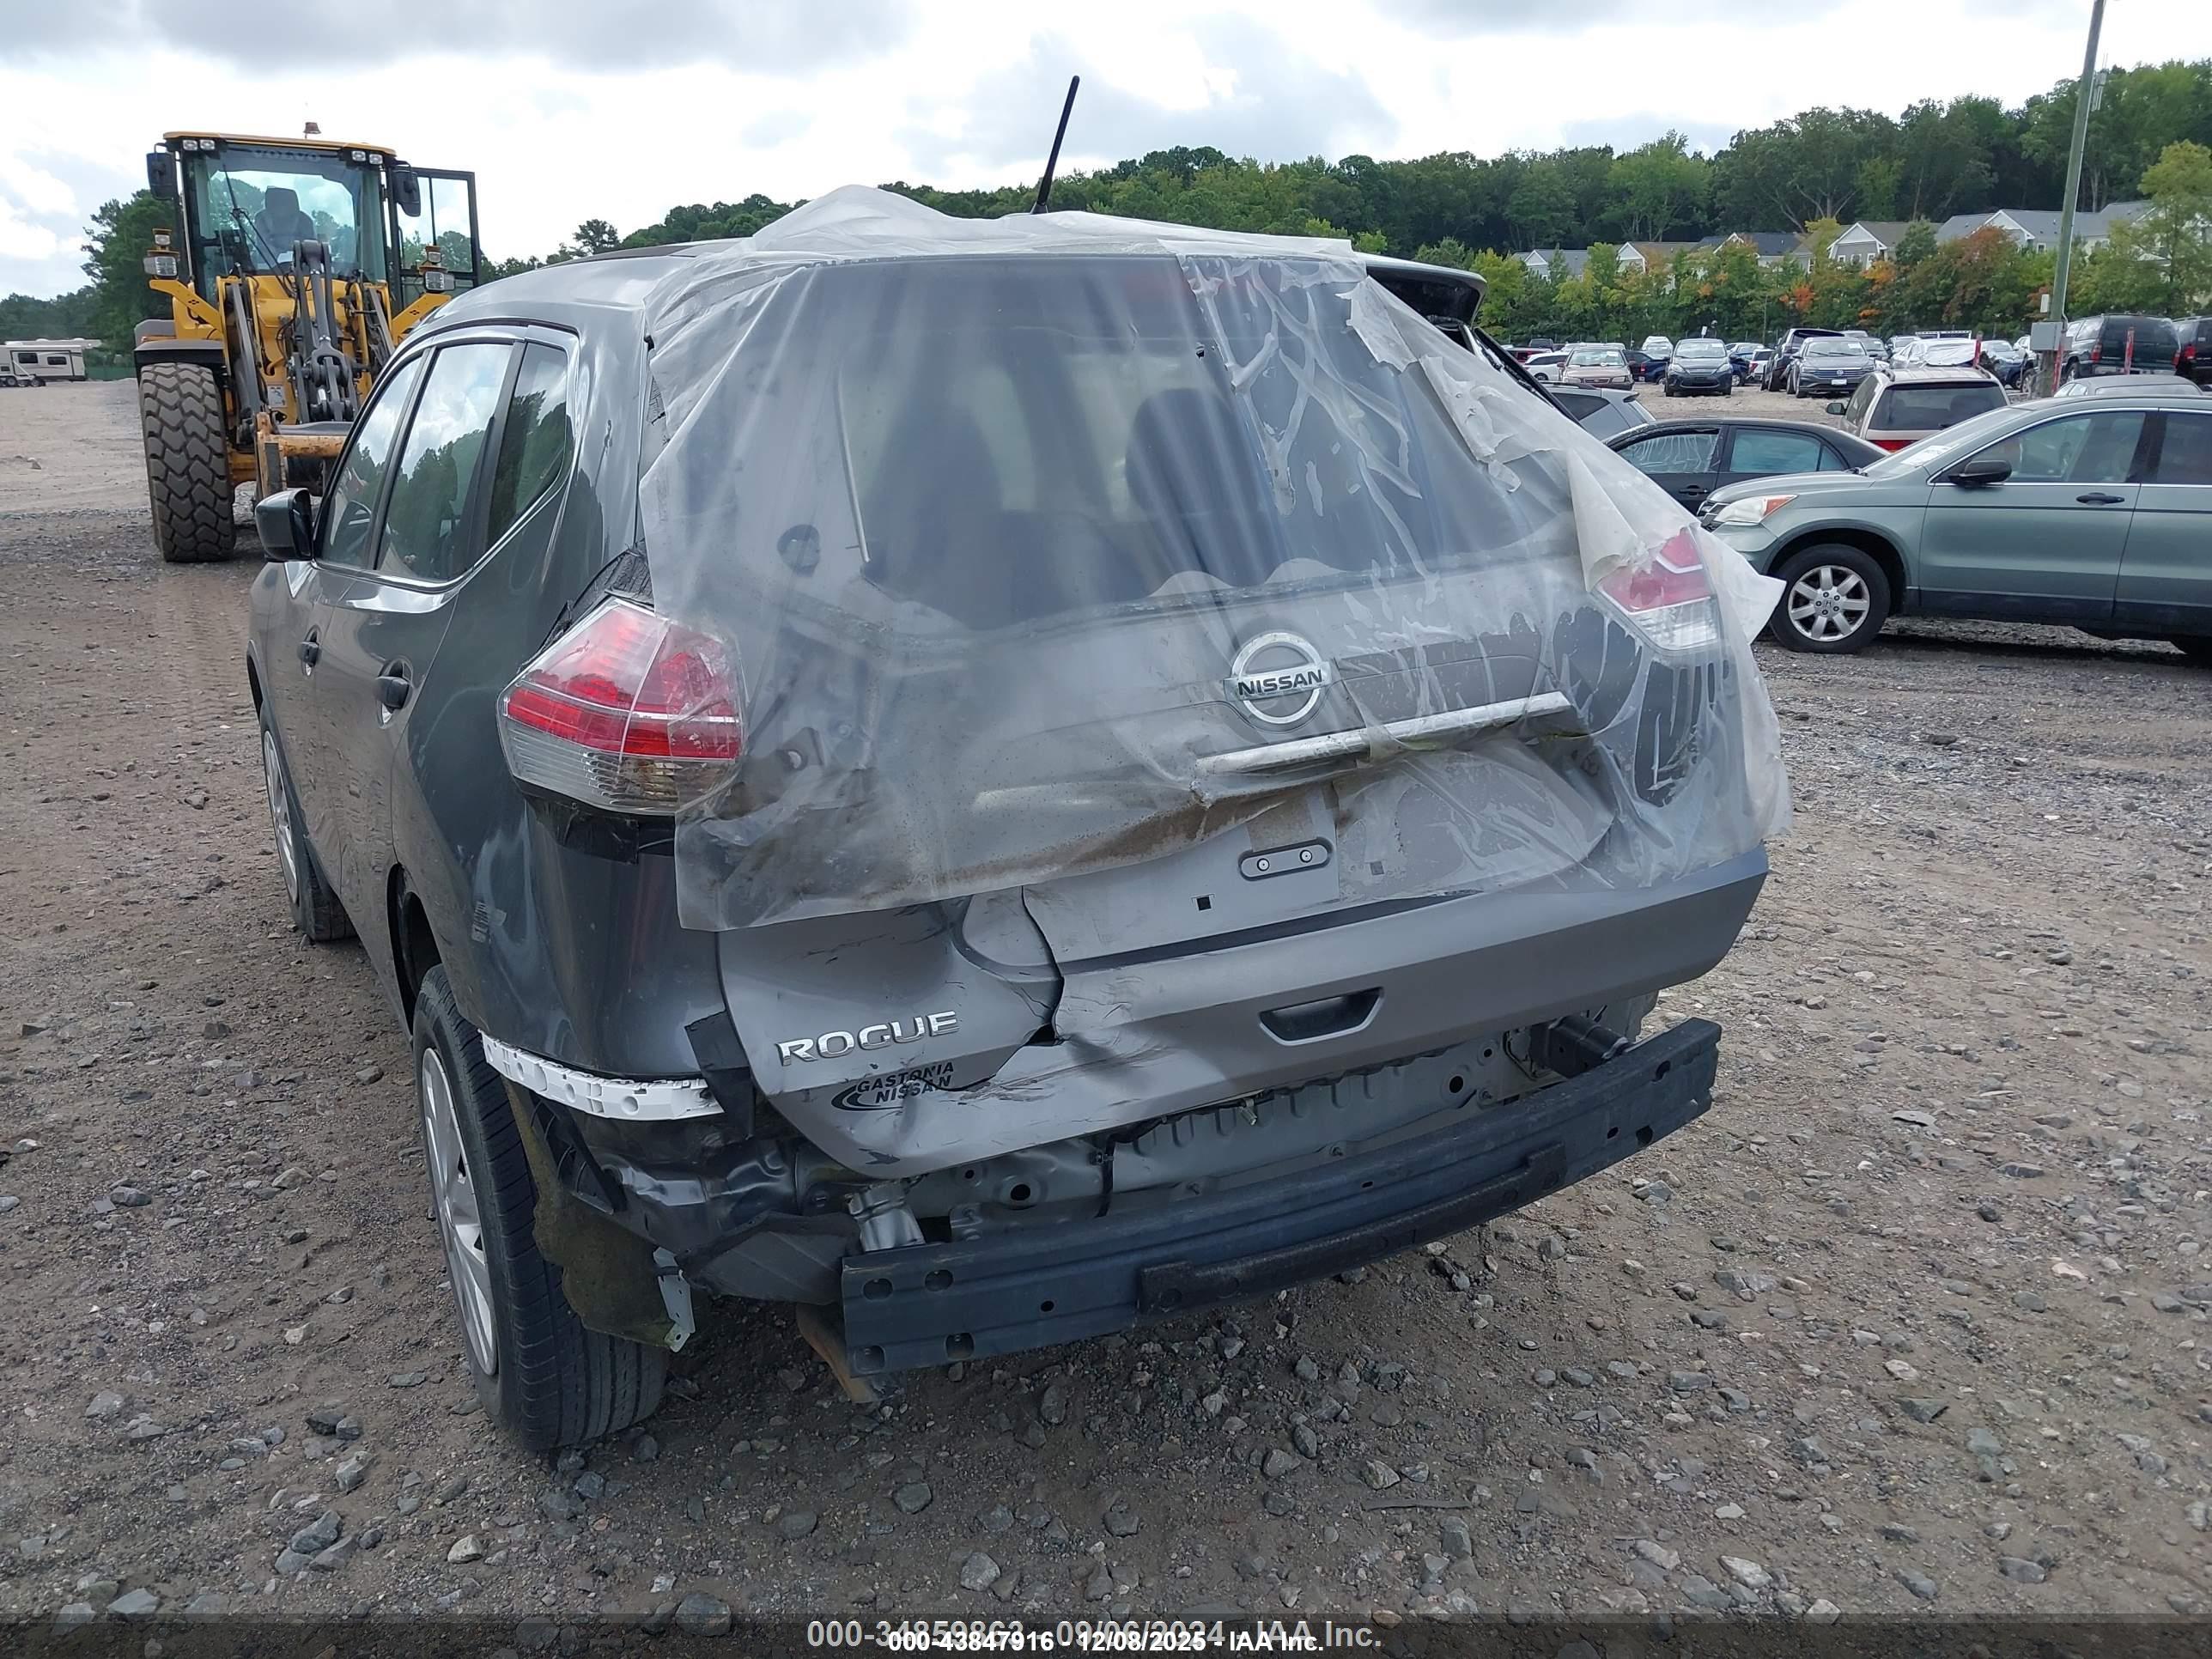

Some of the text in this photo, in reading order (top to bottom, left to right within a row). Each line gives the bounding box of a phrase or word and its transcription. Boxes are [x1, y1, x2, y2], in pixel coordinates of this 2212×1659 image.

[1237, 669, 1322, 696] NISSAN
[776, 1010, 959, 1066] ROGUE
[858, 1061, 954, 1093] GASTONIA
[875, 1075, 951, 1104] NISSAN
